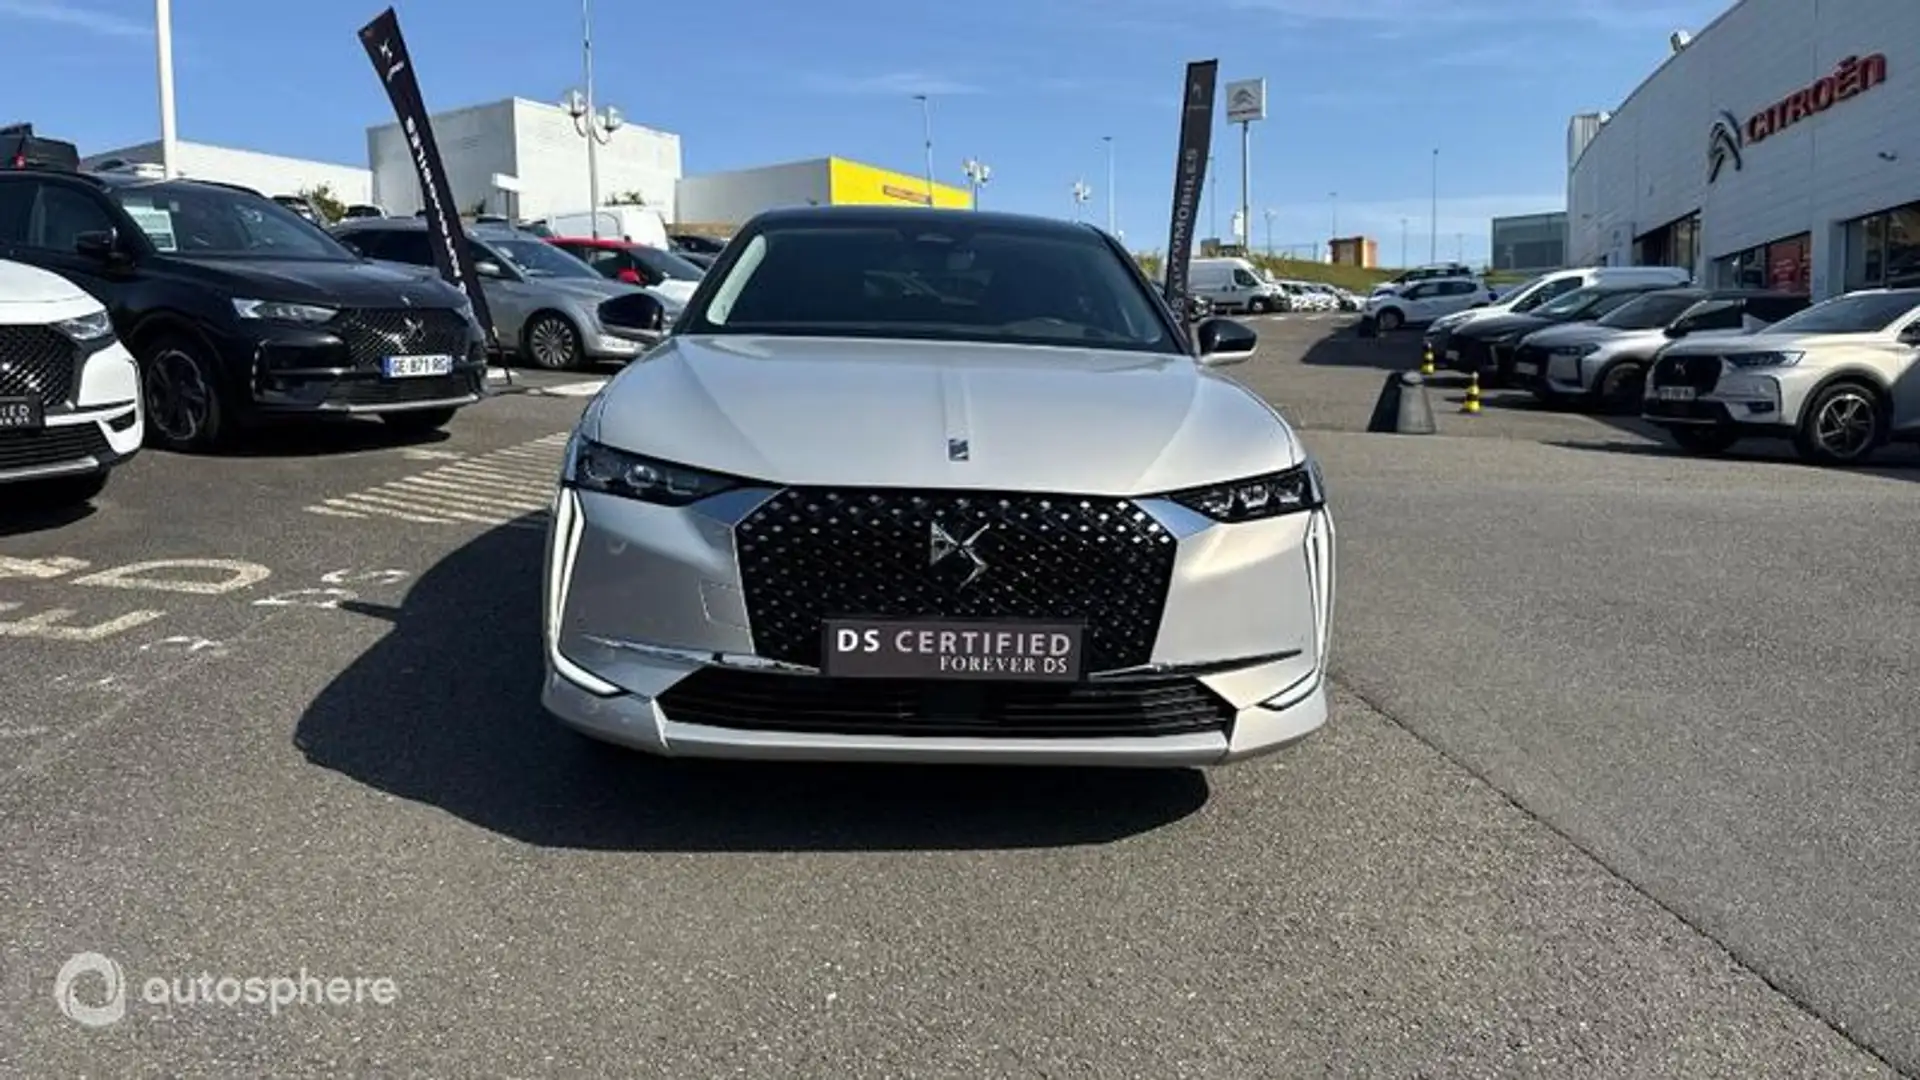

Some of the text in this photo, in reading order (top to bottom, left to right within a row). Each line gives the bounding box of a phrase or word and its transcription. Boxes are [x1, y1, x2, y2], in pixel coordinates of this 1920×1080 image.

[836, 628, 1071, 657] DS CERTIFIED
[939, 654, 1068, 675] FOREVER DS
